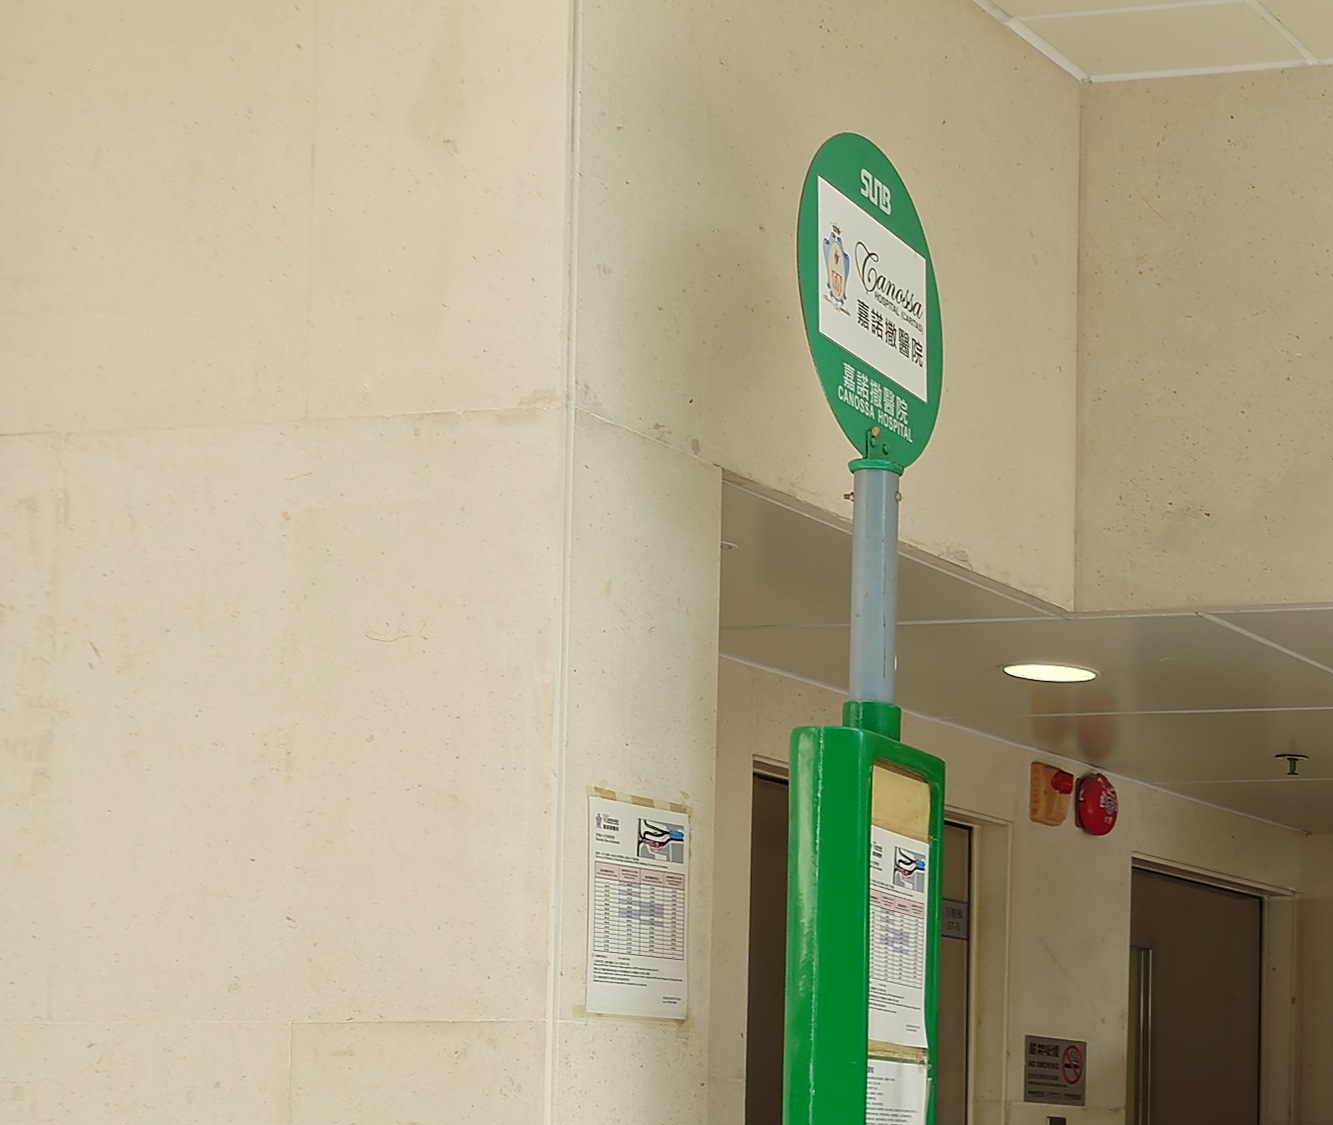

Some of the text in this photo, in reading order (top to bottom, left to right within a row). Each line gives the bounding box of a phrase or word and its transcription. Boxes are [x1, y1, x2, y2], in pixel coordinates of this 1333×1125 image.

[855, 241, 923, 319] Canossa
[837, 385, 913, 443] CANOSSA HOSPITAL
